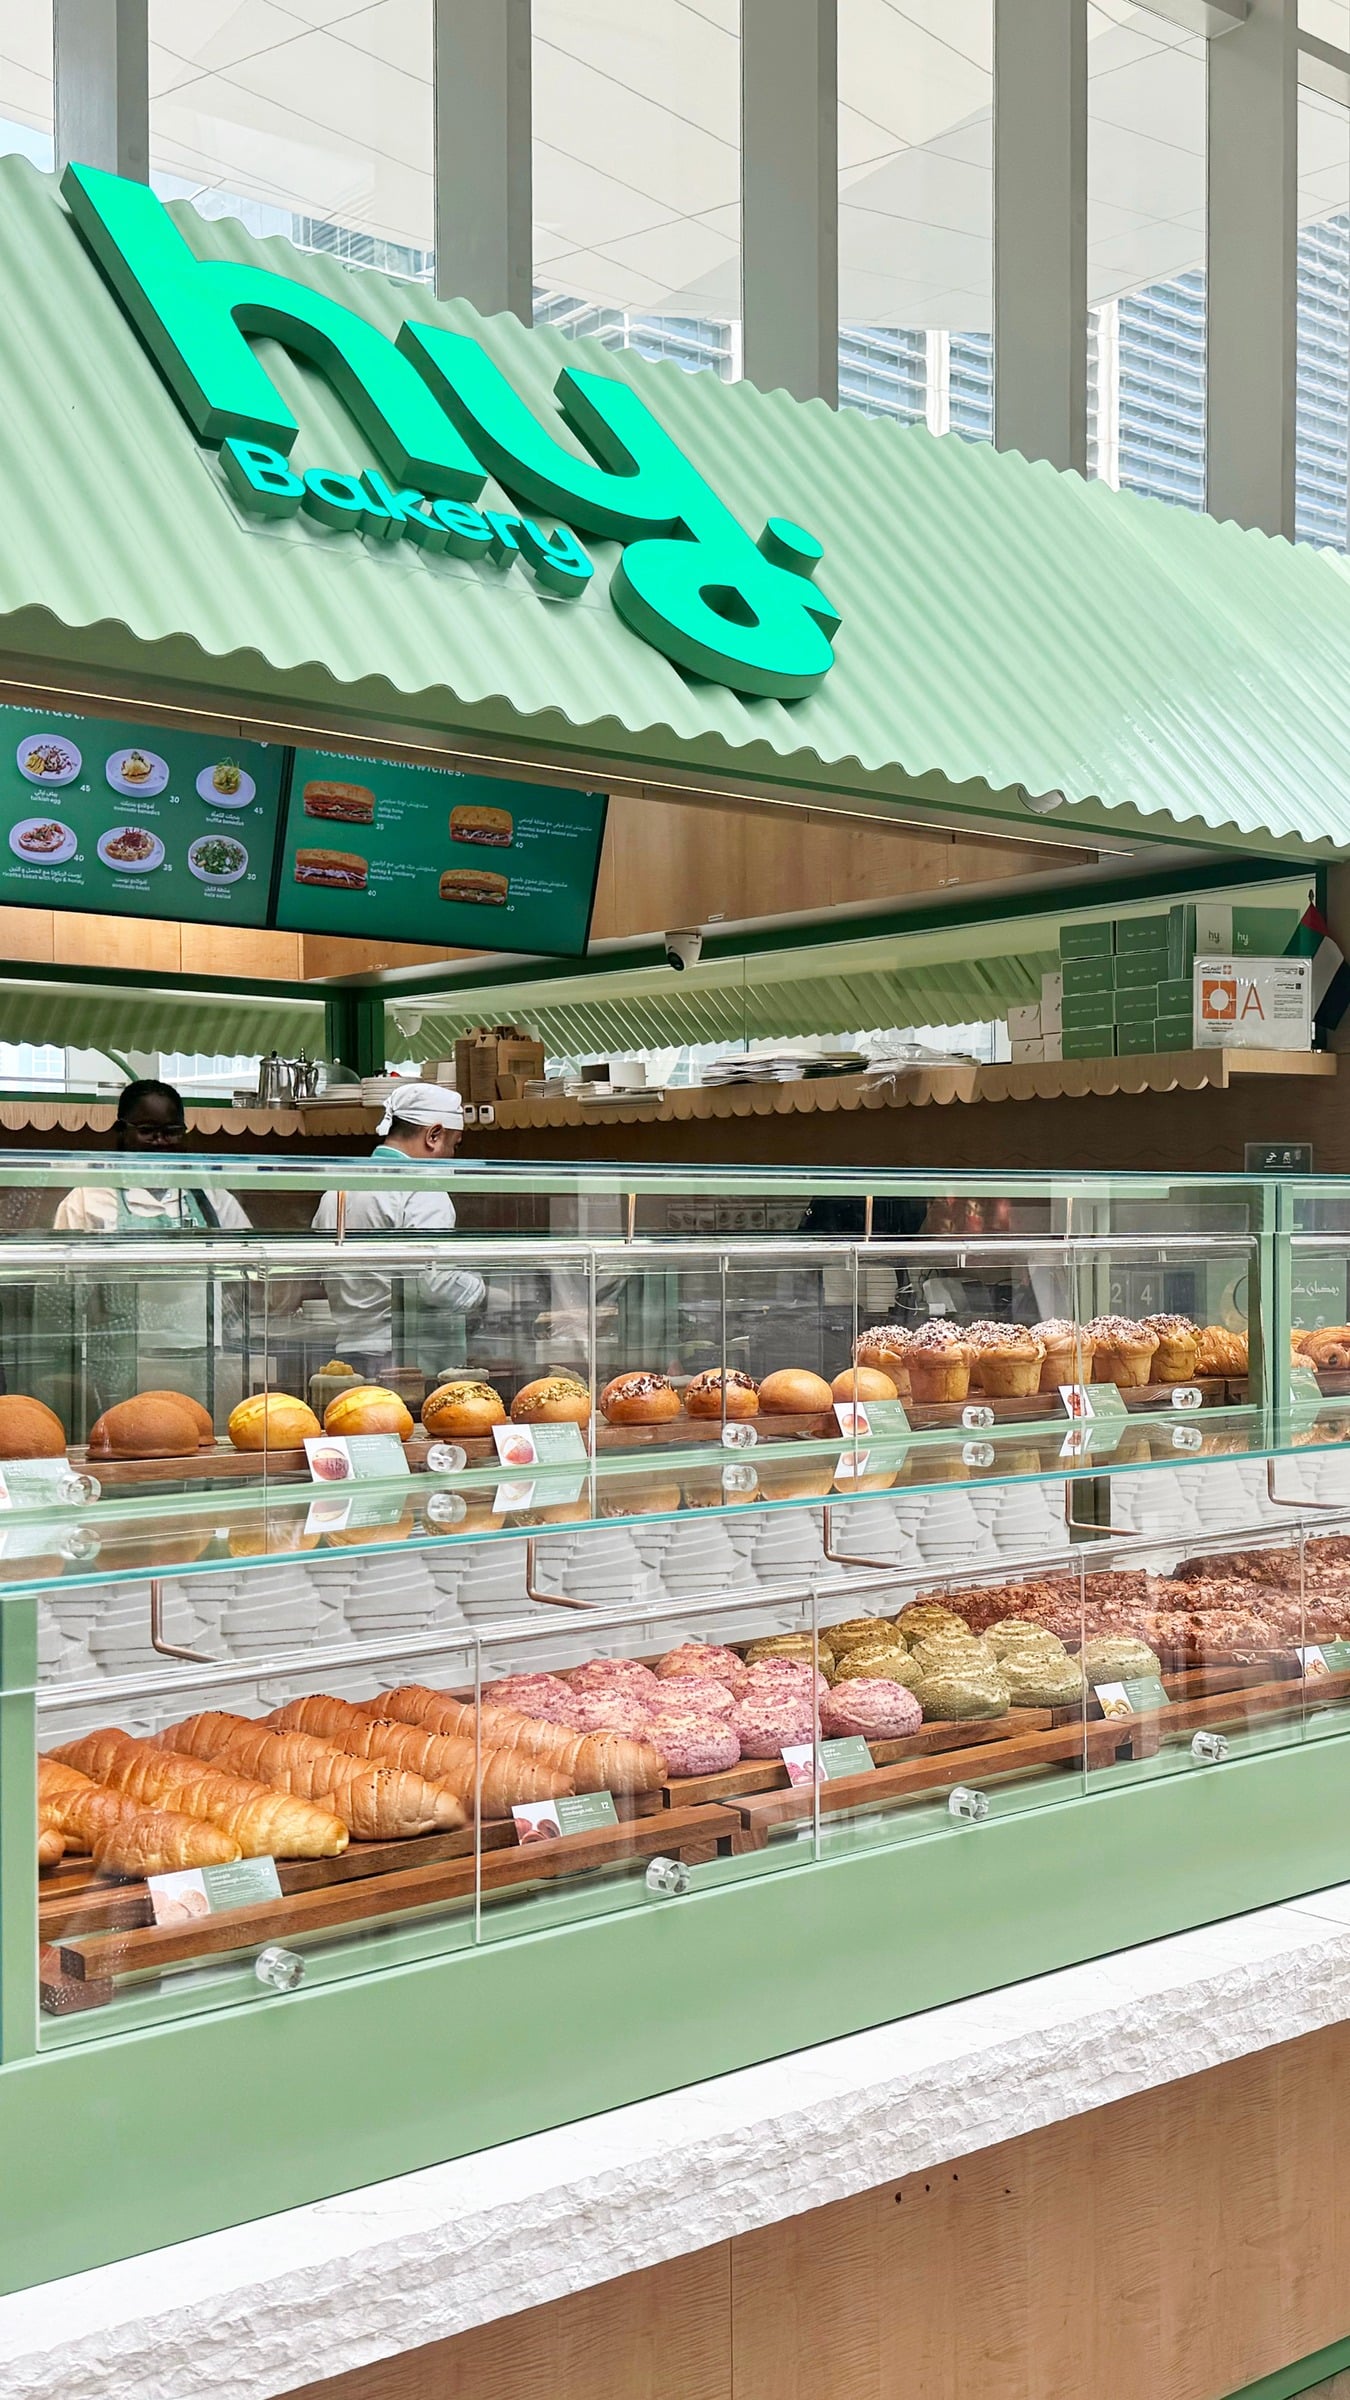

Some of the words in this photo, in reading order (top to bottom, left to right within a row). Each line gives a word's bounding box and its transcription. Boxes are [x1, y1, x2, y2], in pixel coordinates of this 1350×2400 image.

[219, 437, 594, 590] Bakery
[253, 807, 264, 815] 45
[1208, 930, 1220, 944] hy
[1237, 931, 1249, 945] hy
[1240, 983, 1265, 1021] A
[1111, 1282, 1122, 1303] 2
[1140, 1284, 1153, 1305] 4
[1306, 1280, 1340, 1296] رمضان
[600, 1801, 610, 1809] 12
[260, 1867, 271, 1876] 12
